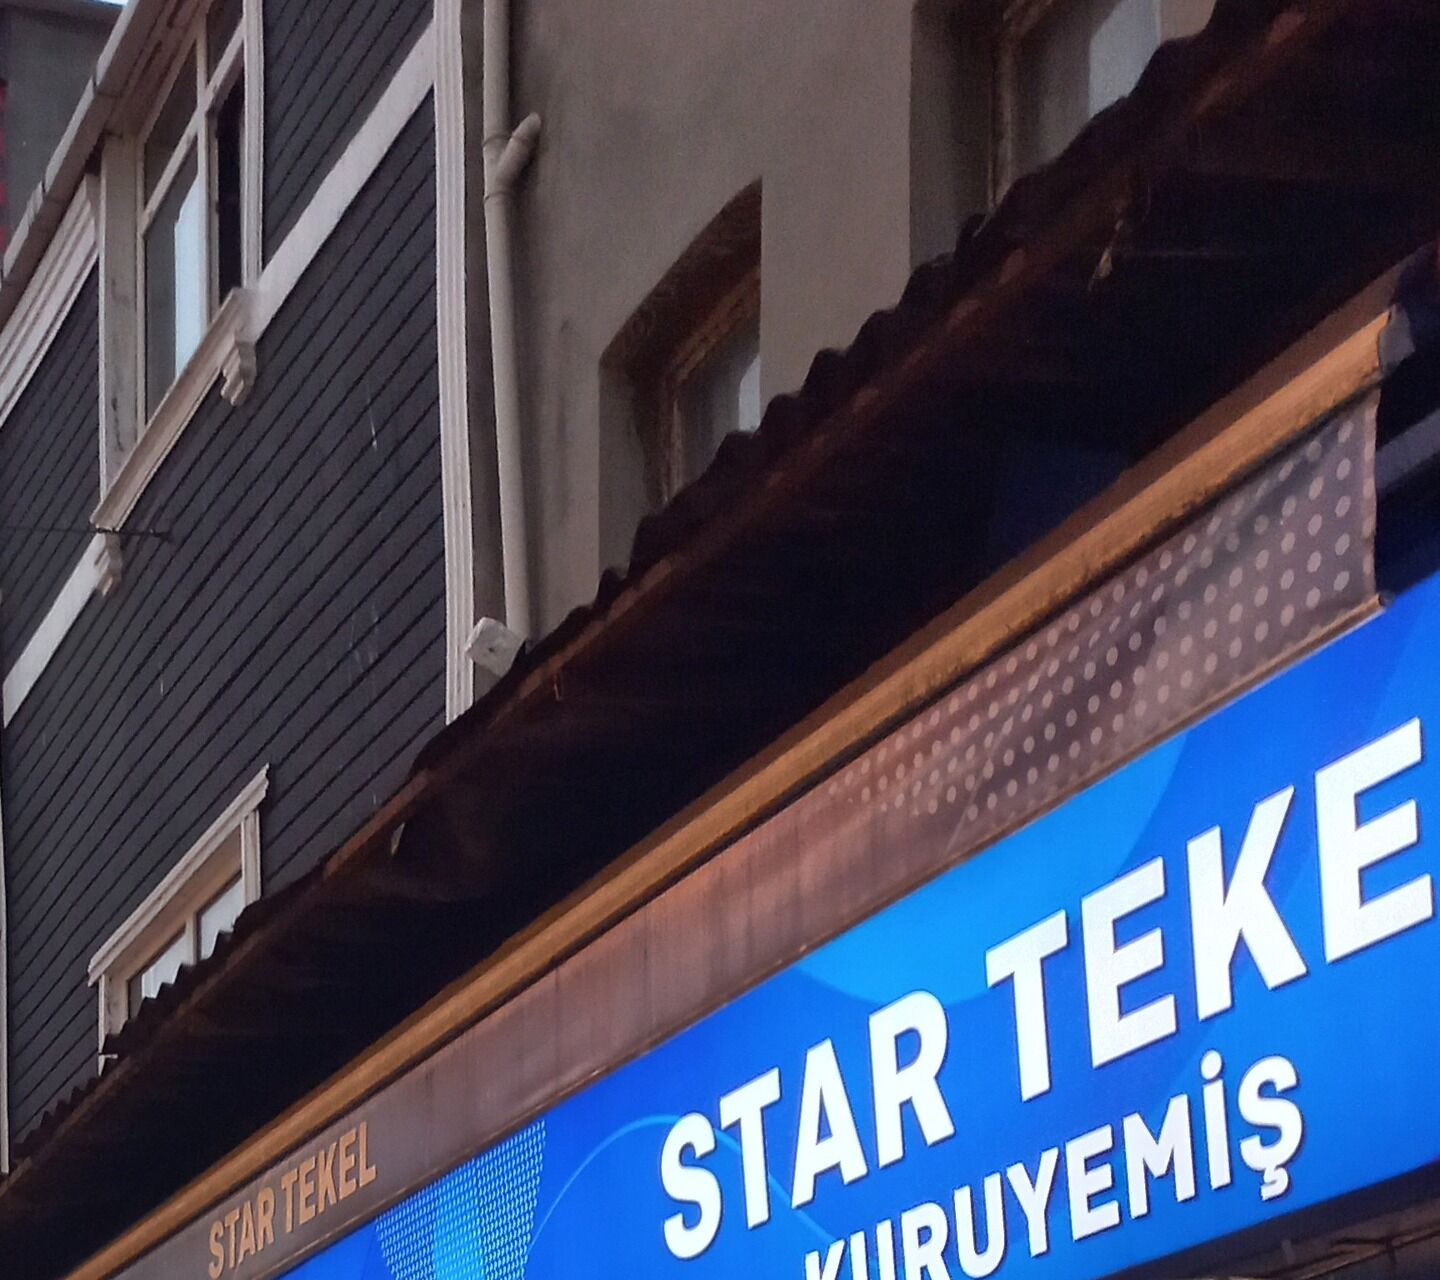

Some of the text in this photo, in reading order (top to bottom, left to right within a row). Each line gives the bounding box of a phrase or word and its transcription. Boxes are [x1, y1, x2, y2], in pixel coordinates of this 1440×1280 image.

[208, 1120, 378, 1280] STAR TEKEL
[659, 989, 955, 1261] STAR
